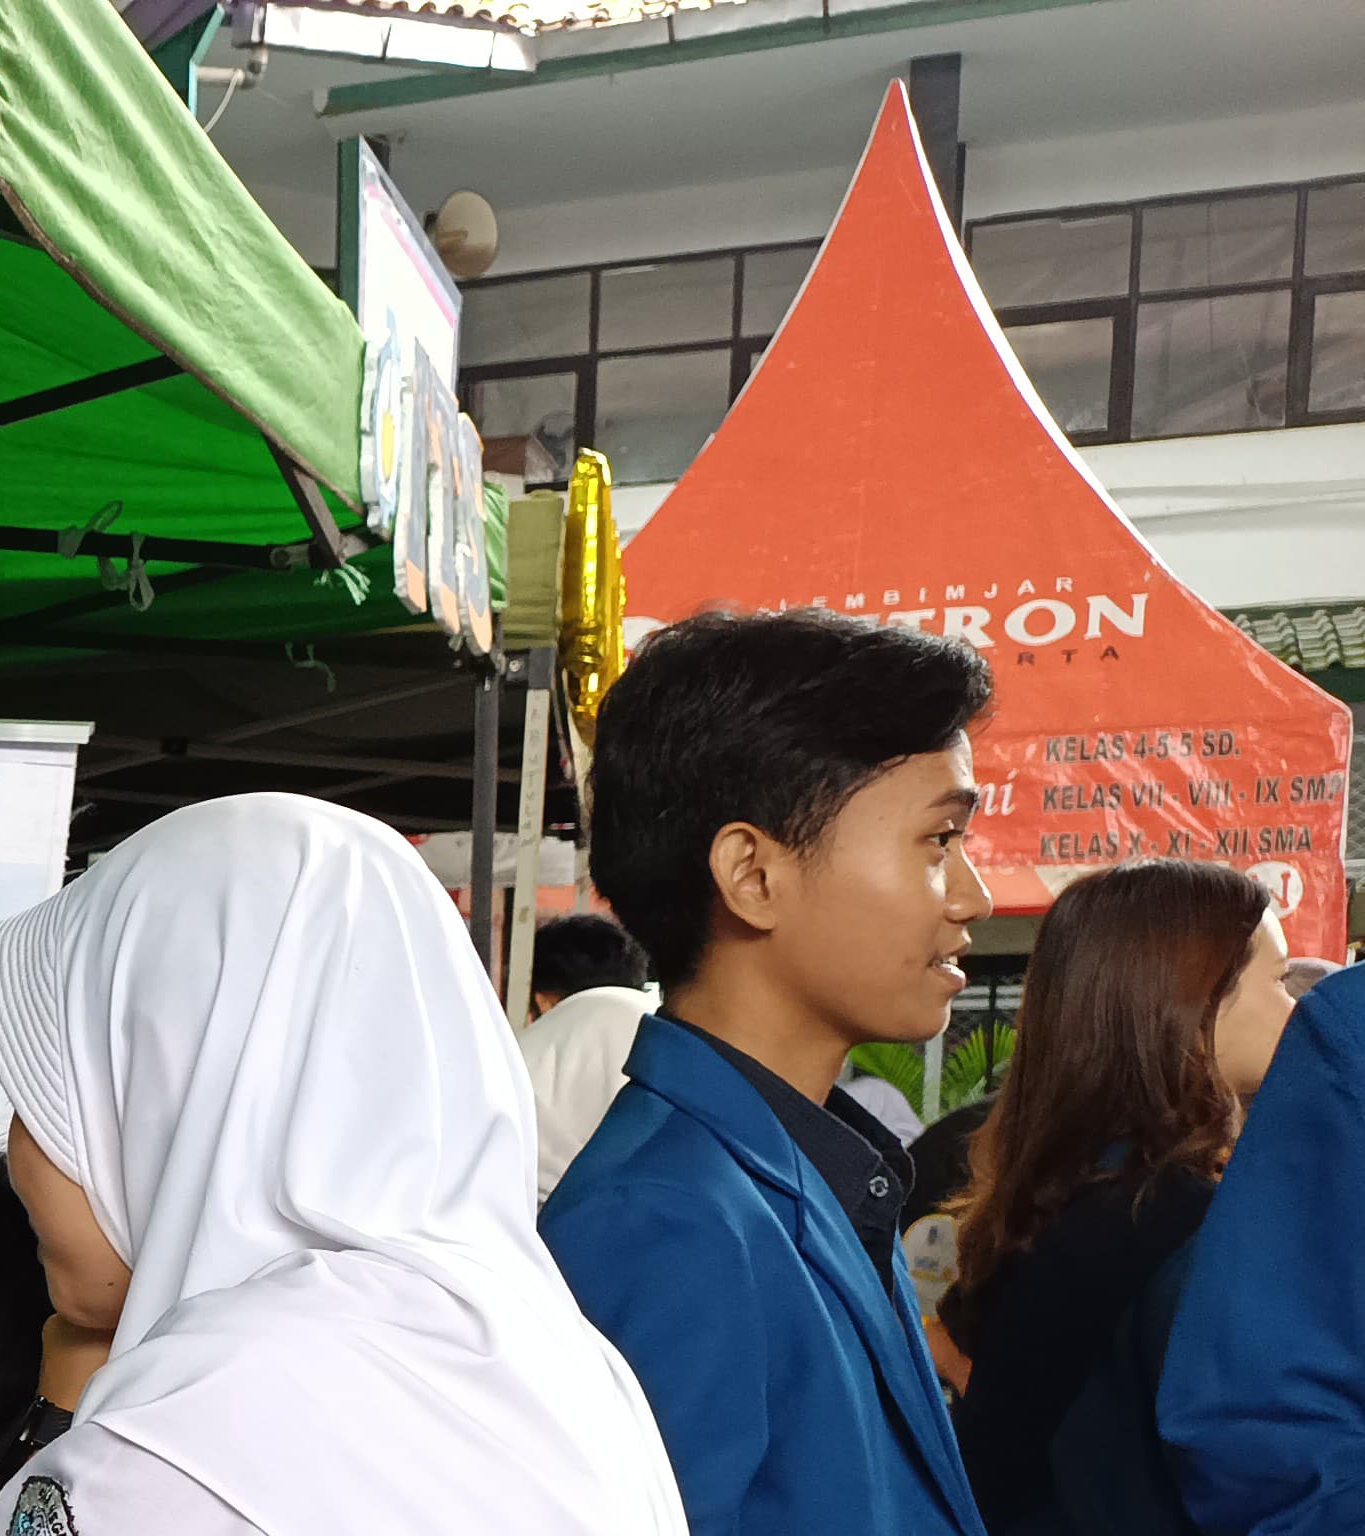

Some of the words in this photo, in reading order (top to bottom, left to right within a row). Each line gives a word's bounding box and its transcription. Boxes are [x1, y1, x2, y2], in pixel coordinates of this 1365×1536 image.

[1045, 735, 1125, 762] KELAS
[1201, 729, 1241, 758] SD.
[1043, 784, 1122, 812] KELAS
[1132, 780, 1165, 808] VII
[1255, 777, 1280, 805] IX
[1040, 832, 1119, 860] KELAS
[1128, 830, 1144, 856] X
[1168, 830, 1192, 855] XI
[1216, 828, 1250, 855] XII
[1258, 825, 1313, 854] SMA
